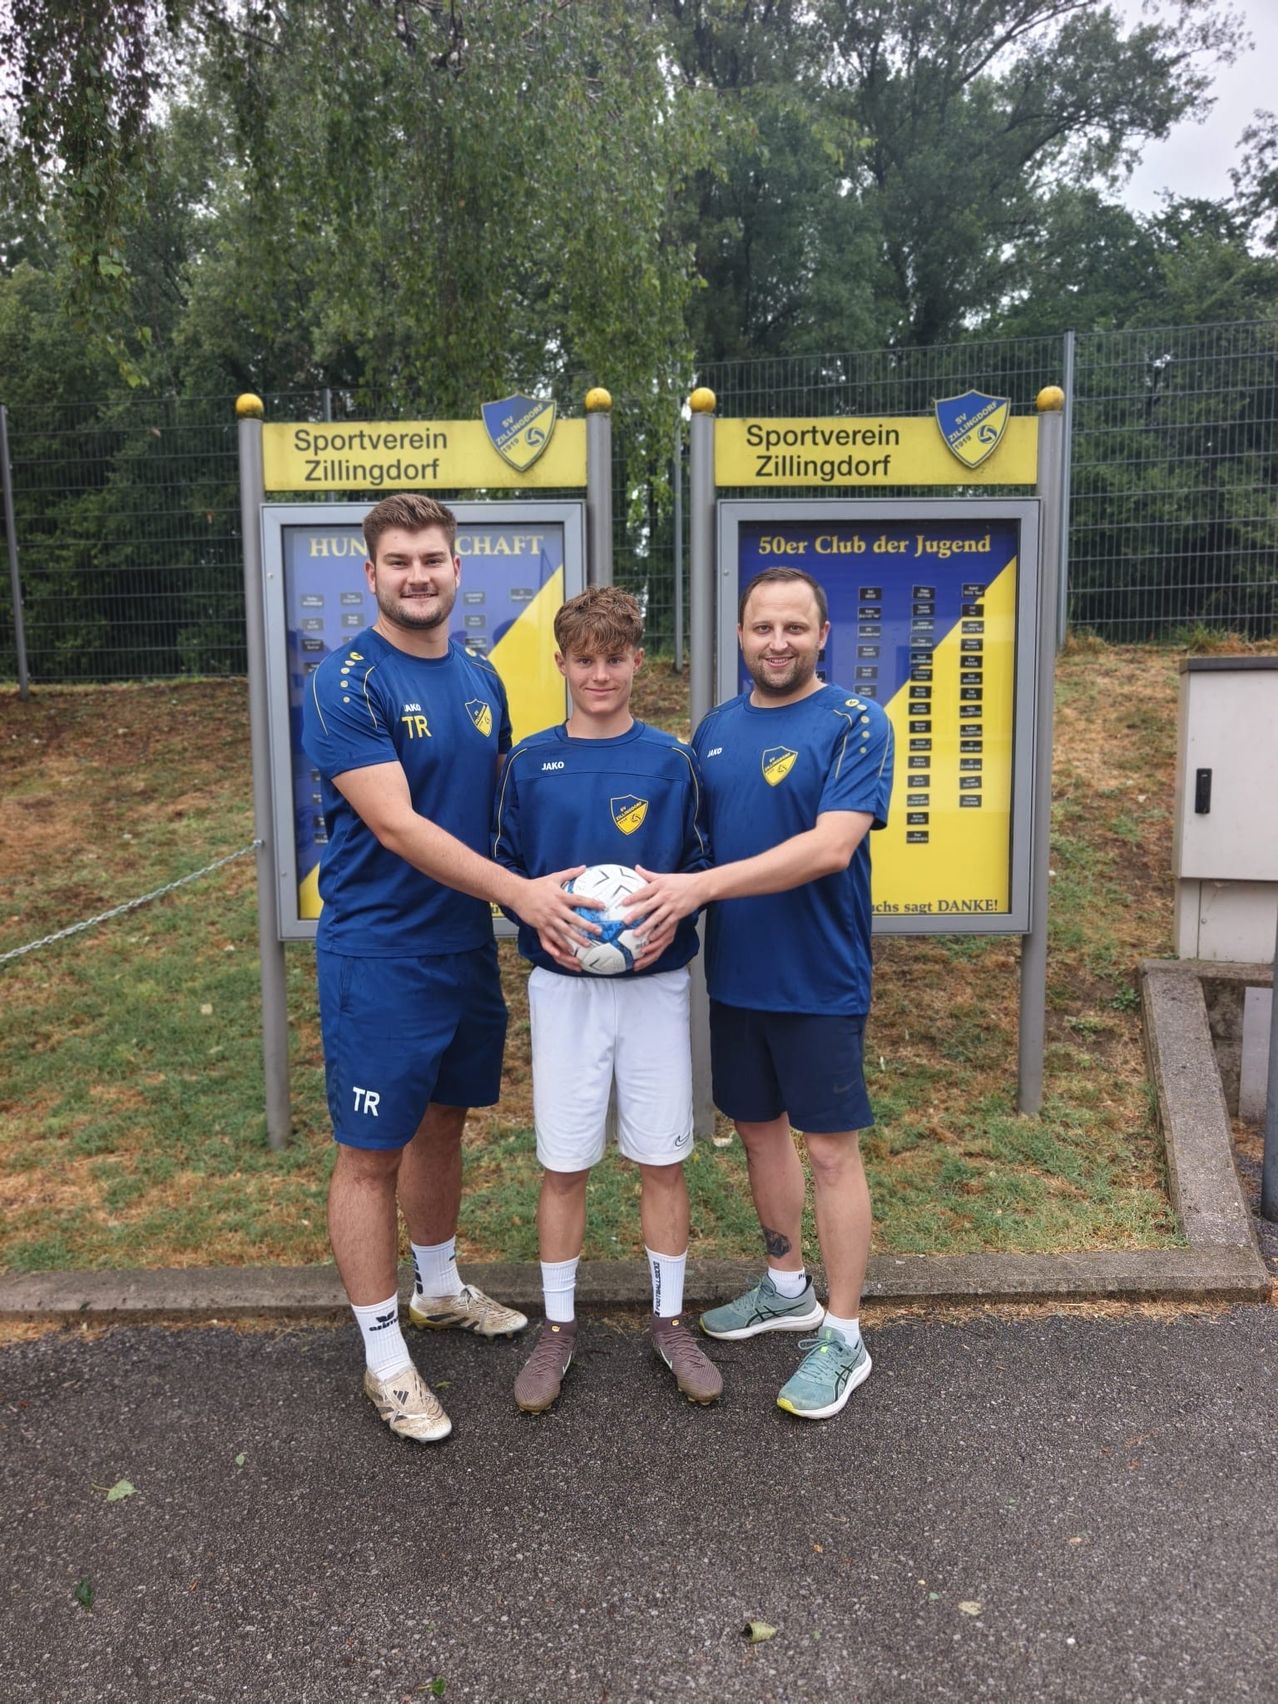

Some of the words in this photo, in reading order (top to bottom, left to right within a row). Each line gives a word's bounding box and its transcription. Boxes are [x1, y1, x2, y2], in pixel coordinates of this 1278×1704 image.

[294, 427, 448, 456] Sportverein
[747, 424, 900, 452] Sportverein
[304, 458, 439, 487] Zillingdorf
[755, 454, 891, 482] Zillingdorf
[758, 536, 808, 555] 50er
[815, 535, 866, 554] Club
[873, 535, 909, 553] der
[914, 534, 991, 558] Jugend
[401, 715, 432, 739] TR
[541, 761, 565, 771] JAKO
[904, 903, 932, 914] sagt
[937, 899, 998, 912] DANKE!
[352, 1086, 380, 1117] TR
